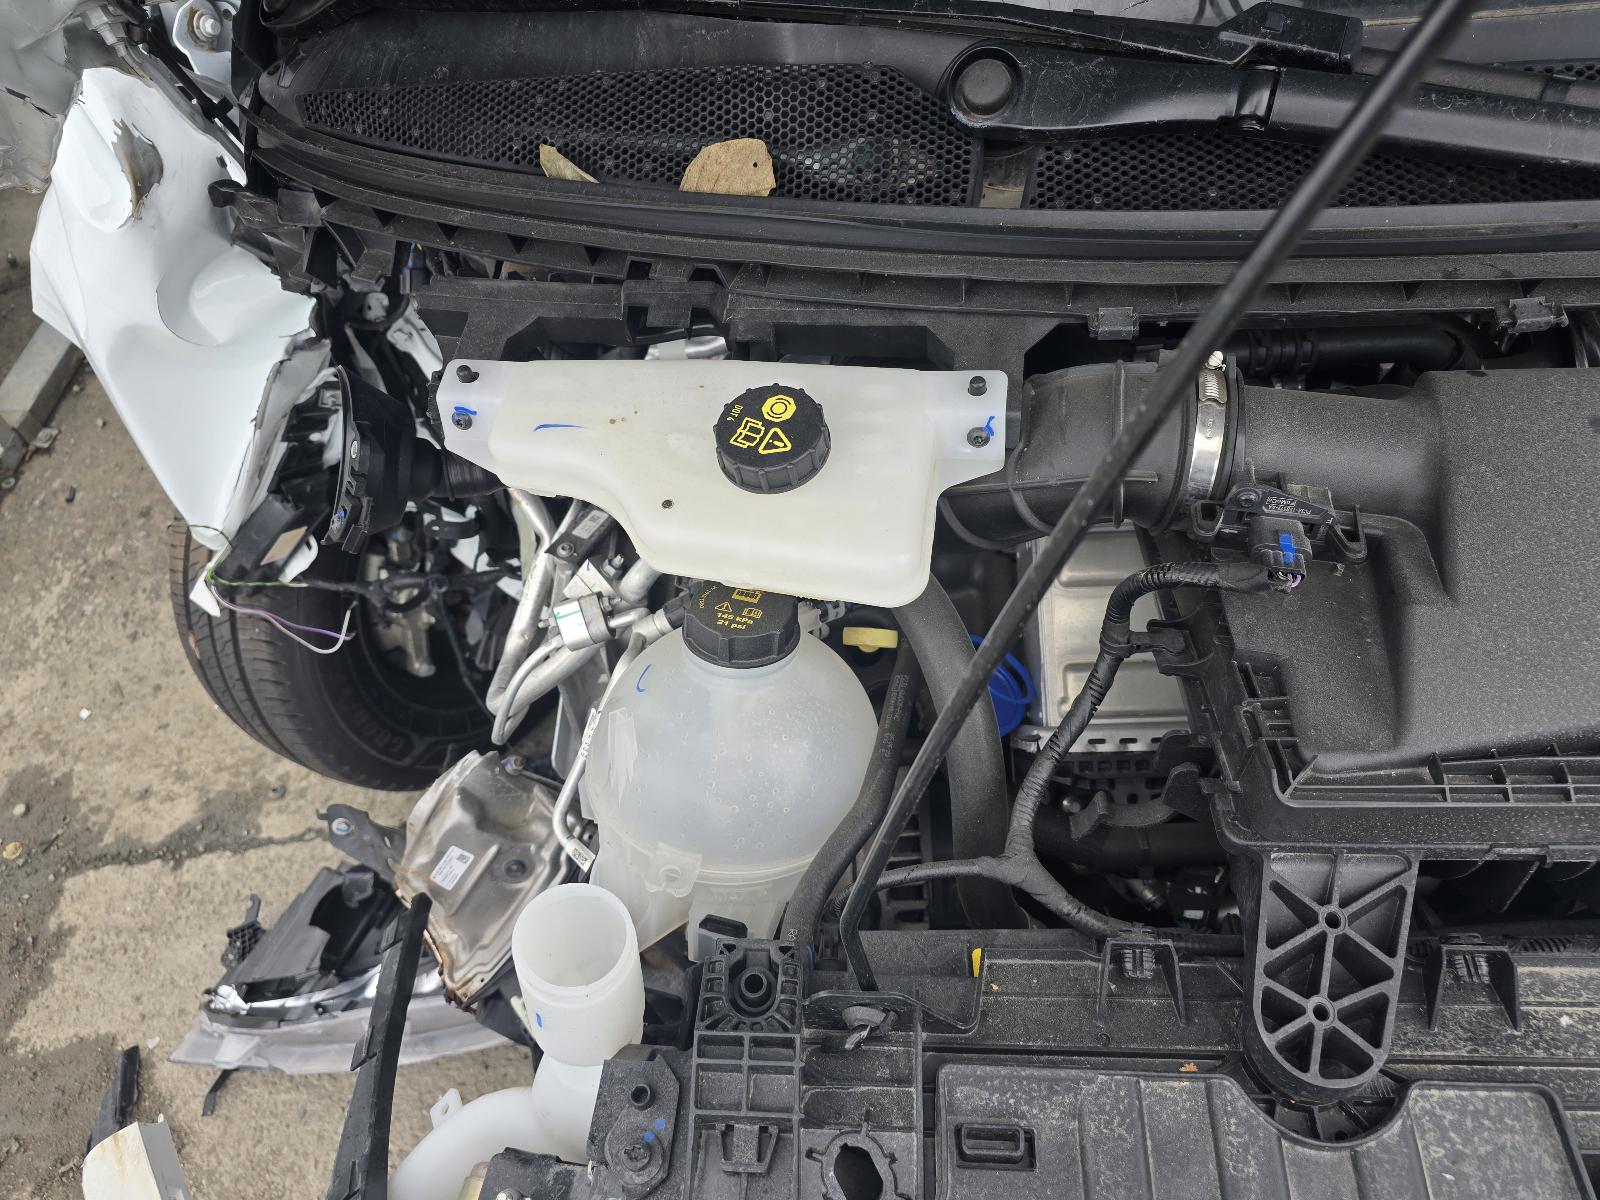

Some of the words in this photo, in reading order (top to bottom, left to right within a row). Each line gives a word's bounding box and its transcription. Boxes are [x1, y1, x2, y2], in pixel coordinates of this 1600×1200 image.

[732, 404, 744, 418] DOT
[716, 612, 734, 620] 145
[736, 616, 754, 625] kPa
